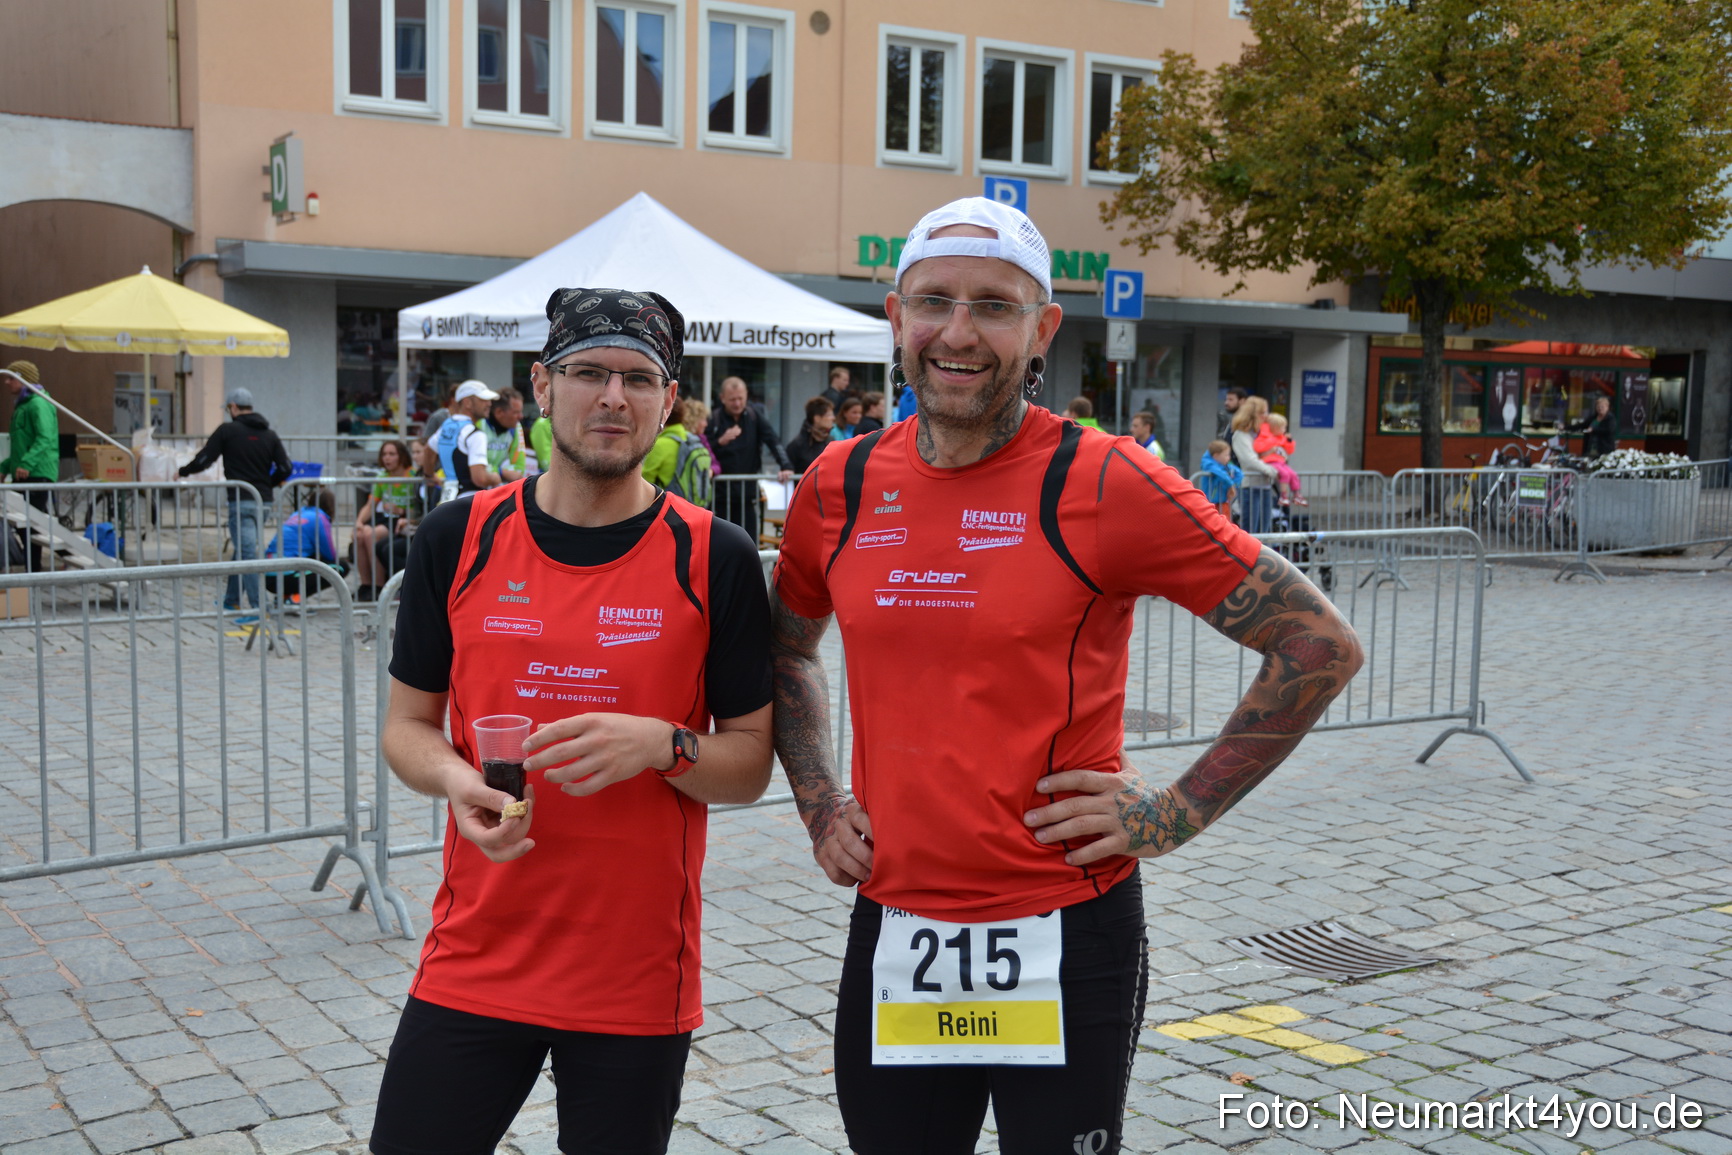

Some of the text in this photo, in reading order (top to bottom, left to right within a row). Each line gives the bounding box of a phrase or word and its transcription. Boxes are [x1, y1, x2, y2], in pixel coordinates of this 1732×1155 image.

[272, 153, 287, 202] D
[1112, 275, 1136, 313] P
[436, 314, 519, 342] BMW Laufsport
[684, 321, 836, 351] MW Laufsport
[874, 504, 903, 514] erima
[962, 509, 1027, 526] HEINLOTH
[961, 522, 1026, 533] CNC-Fertigungstechnik
[957, 534, 1023, 549] Präzisionsteile
[888, 569, 967, 584] Gruber
[498, 593, 530, 604] erima
[898, 599, 975, 608] DIE BADGESTALTER
[598, 606, 663, 621] HEINLOTH
[598, 618, 663, 628] CNC-Fertigungstechnik
[595, 629, 661, 643] Präzisionsteile
[527, 661, 608, 679] Gruber
[540, 692, 617, 704] DIE BADGESTALTER
[910, 927, 1022, 992] 215
[881, 989, 889, 1001] B
[937, 1010, 998, 1037] Reini
